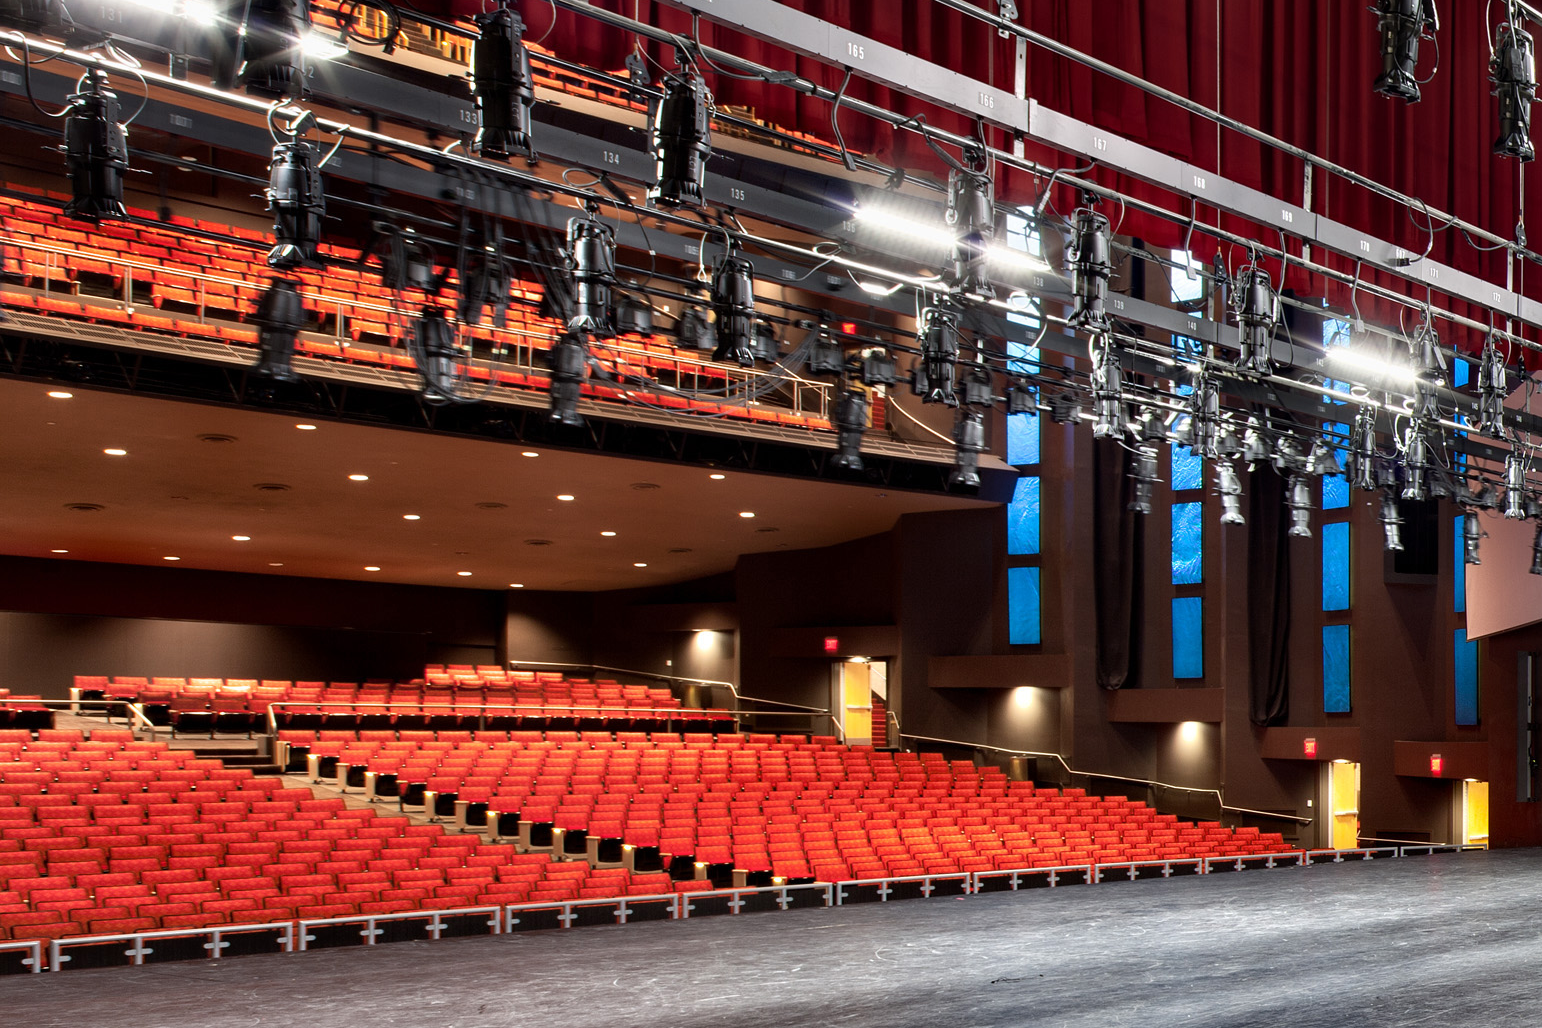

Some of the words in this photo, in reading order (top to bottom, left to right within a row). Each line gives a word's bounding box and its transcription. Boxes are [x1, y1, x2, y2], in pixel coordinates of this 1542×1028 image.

[101, 5, 123, 24] 131
[848, 42, 865, 60] 165
[980, 93, 995, 109] 166
[459, 109, 477, 125] 133
[511, 101, 520, 120] LCT
[1093, 136, 1107, 151] 167
[604, 150, 620, 165] 134
[731, 187, 745, 201] 135
[843, 220, 856, 234] 136
